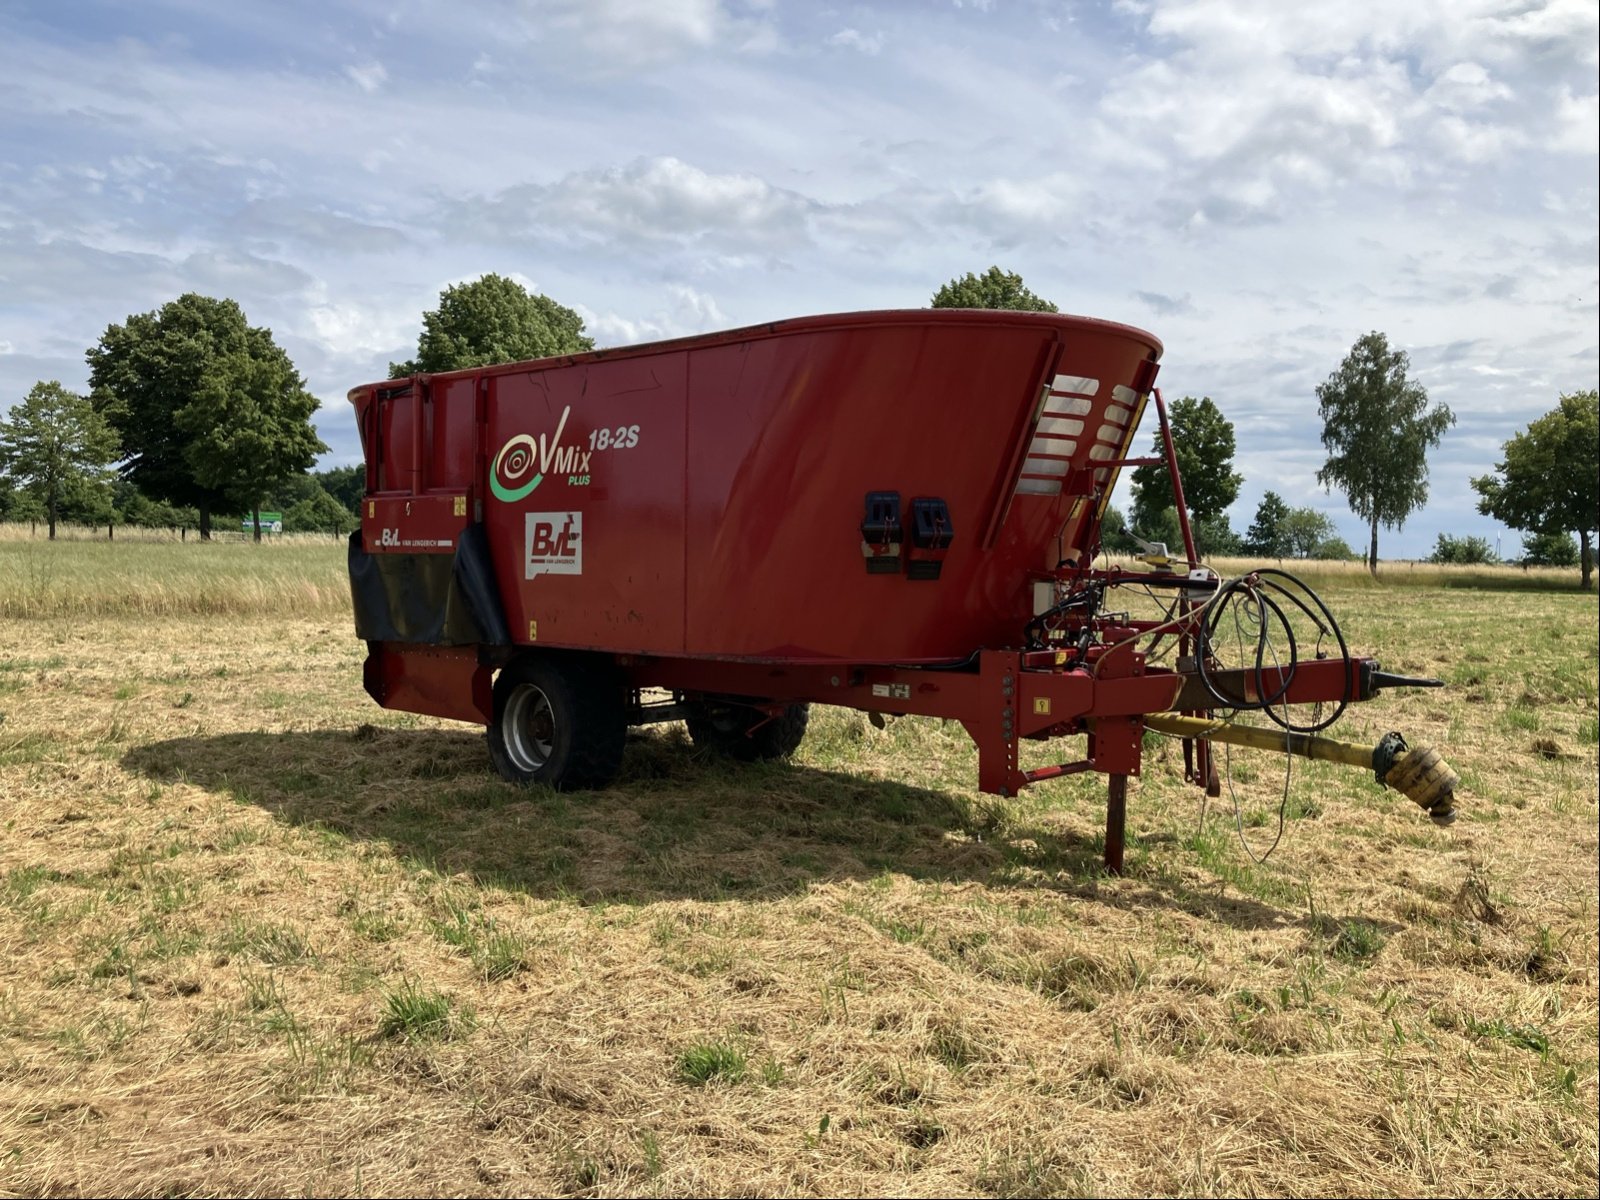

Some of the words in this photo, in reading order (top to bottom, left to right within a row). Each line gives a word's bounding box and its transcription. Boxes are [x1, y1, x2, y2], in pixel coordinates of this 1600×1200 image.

[589, 424, 640, 450] 18-2S
[568, 475, 590, 486] PLUS
[412, 539, 437, 547] LENGERICH
